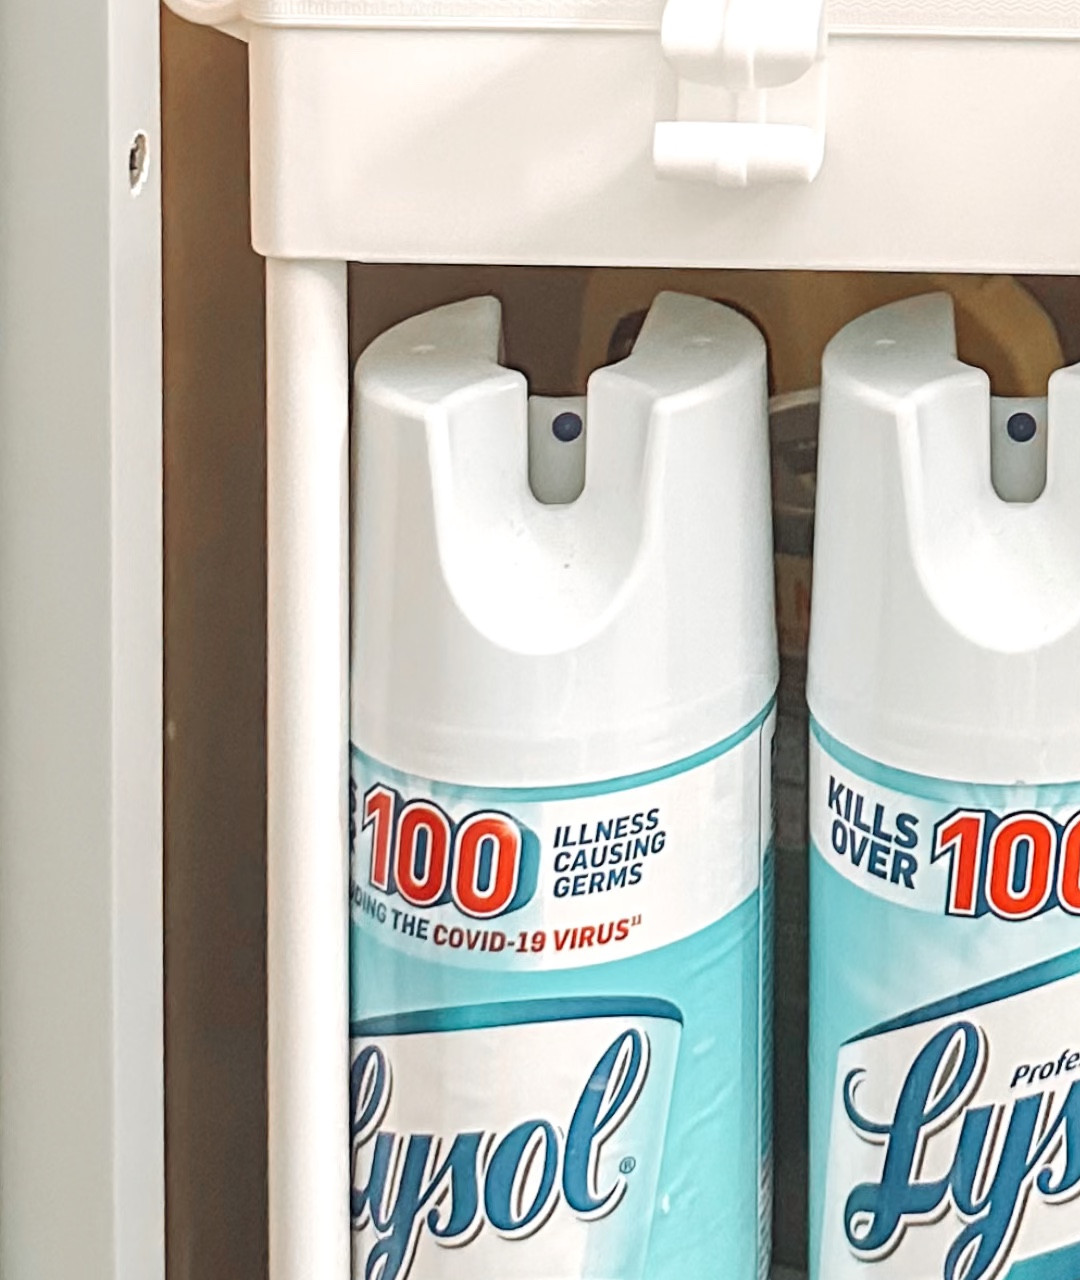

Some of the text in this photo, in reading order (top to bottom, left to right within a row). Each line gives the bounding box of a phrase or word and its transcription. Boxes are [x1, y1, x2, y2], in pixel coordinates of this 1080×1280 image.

[553, 808, 660, 849] ILLNESS
[828, 774, 920, 850] KILLS
[362, 782, 541, 921] 100
[553, 830, 667, 873] CAUSING
[831, 819, 919, 890] OVER
[553, 861, 644, 898] GERMS
[391, 906, 430, 942] THE
[433, 922, 547, 954] COVID-19
